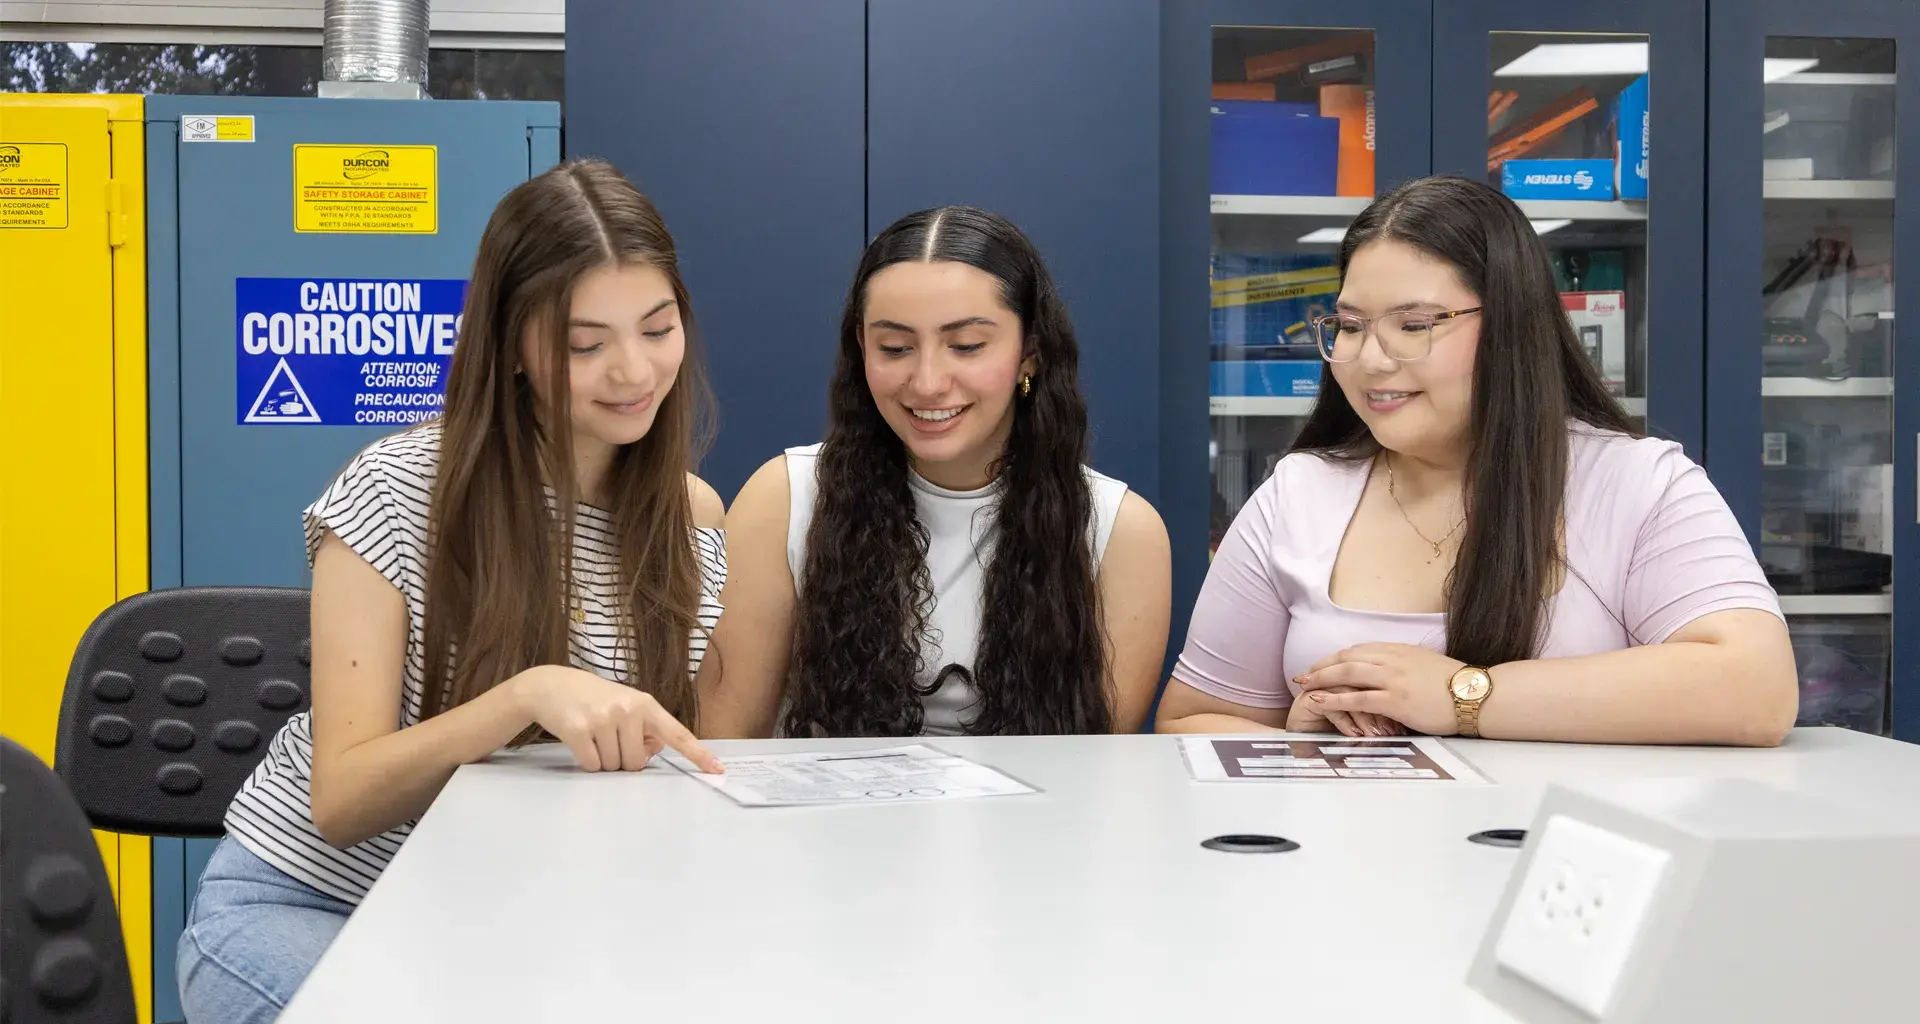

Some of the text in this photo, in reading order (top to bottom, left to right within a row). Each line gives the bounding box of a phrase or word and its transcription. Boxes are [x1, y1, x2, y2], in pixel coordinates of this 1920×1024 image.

[343, 159, 389, 167] DURCON
[1524, 174, 1572, 184] STEREN
[19, 188, 60, 196] CABINET
[1247, 276, 1280, 287] DIGITAL
[300, 282, 421, 312] CAUTION
[1246, 288, 1304, 301] INSTRUMENTS
[360, 362, 440, 374] ATTENTION:
[364, 375, 438, 387] CORROSIF
[354, 411, 445, 423] CORROSIVO
